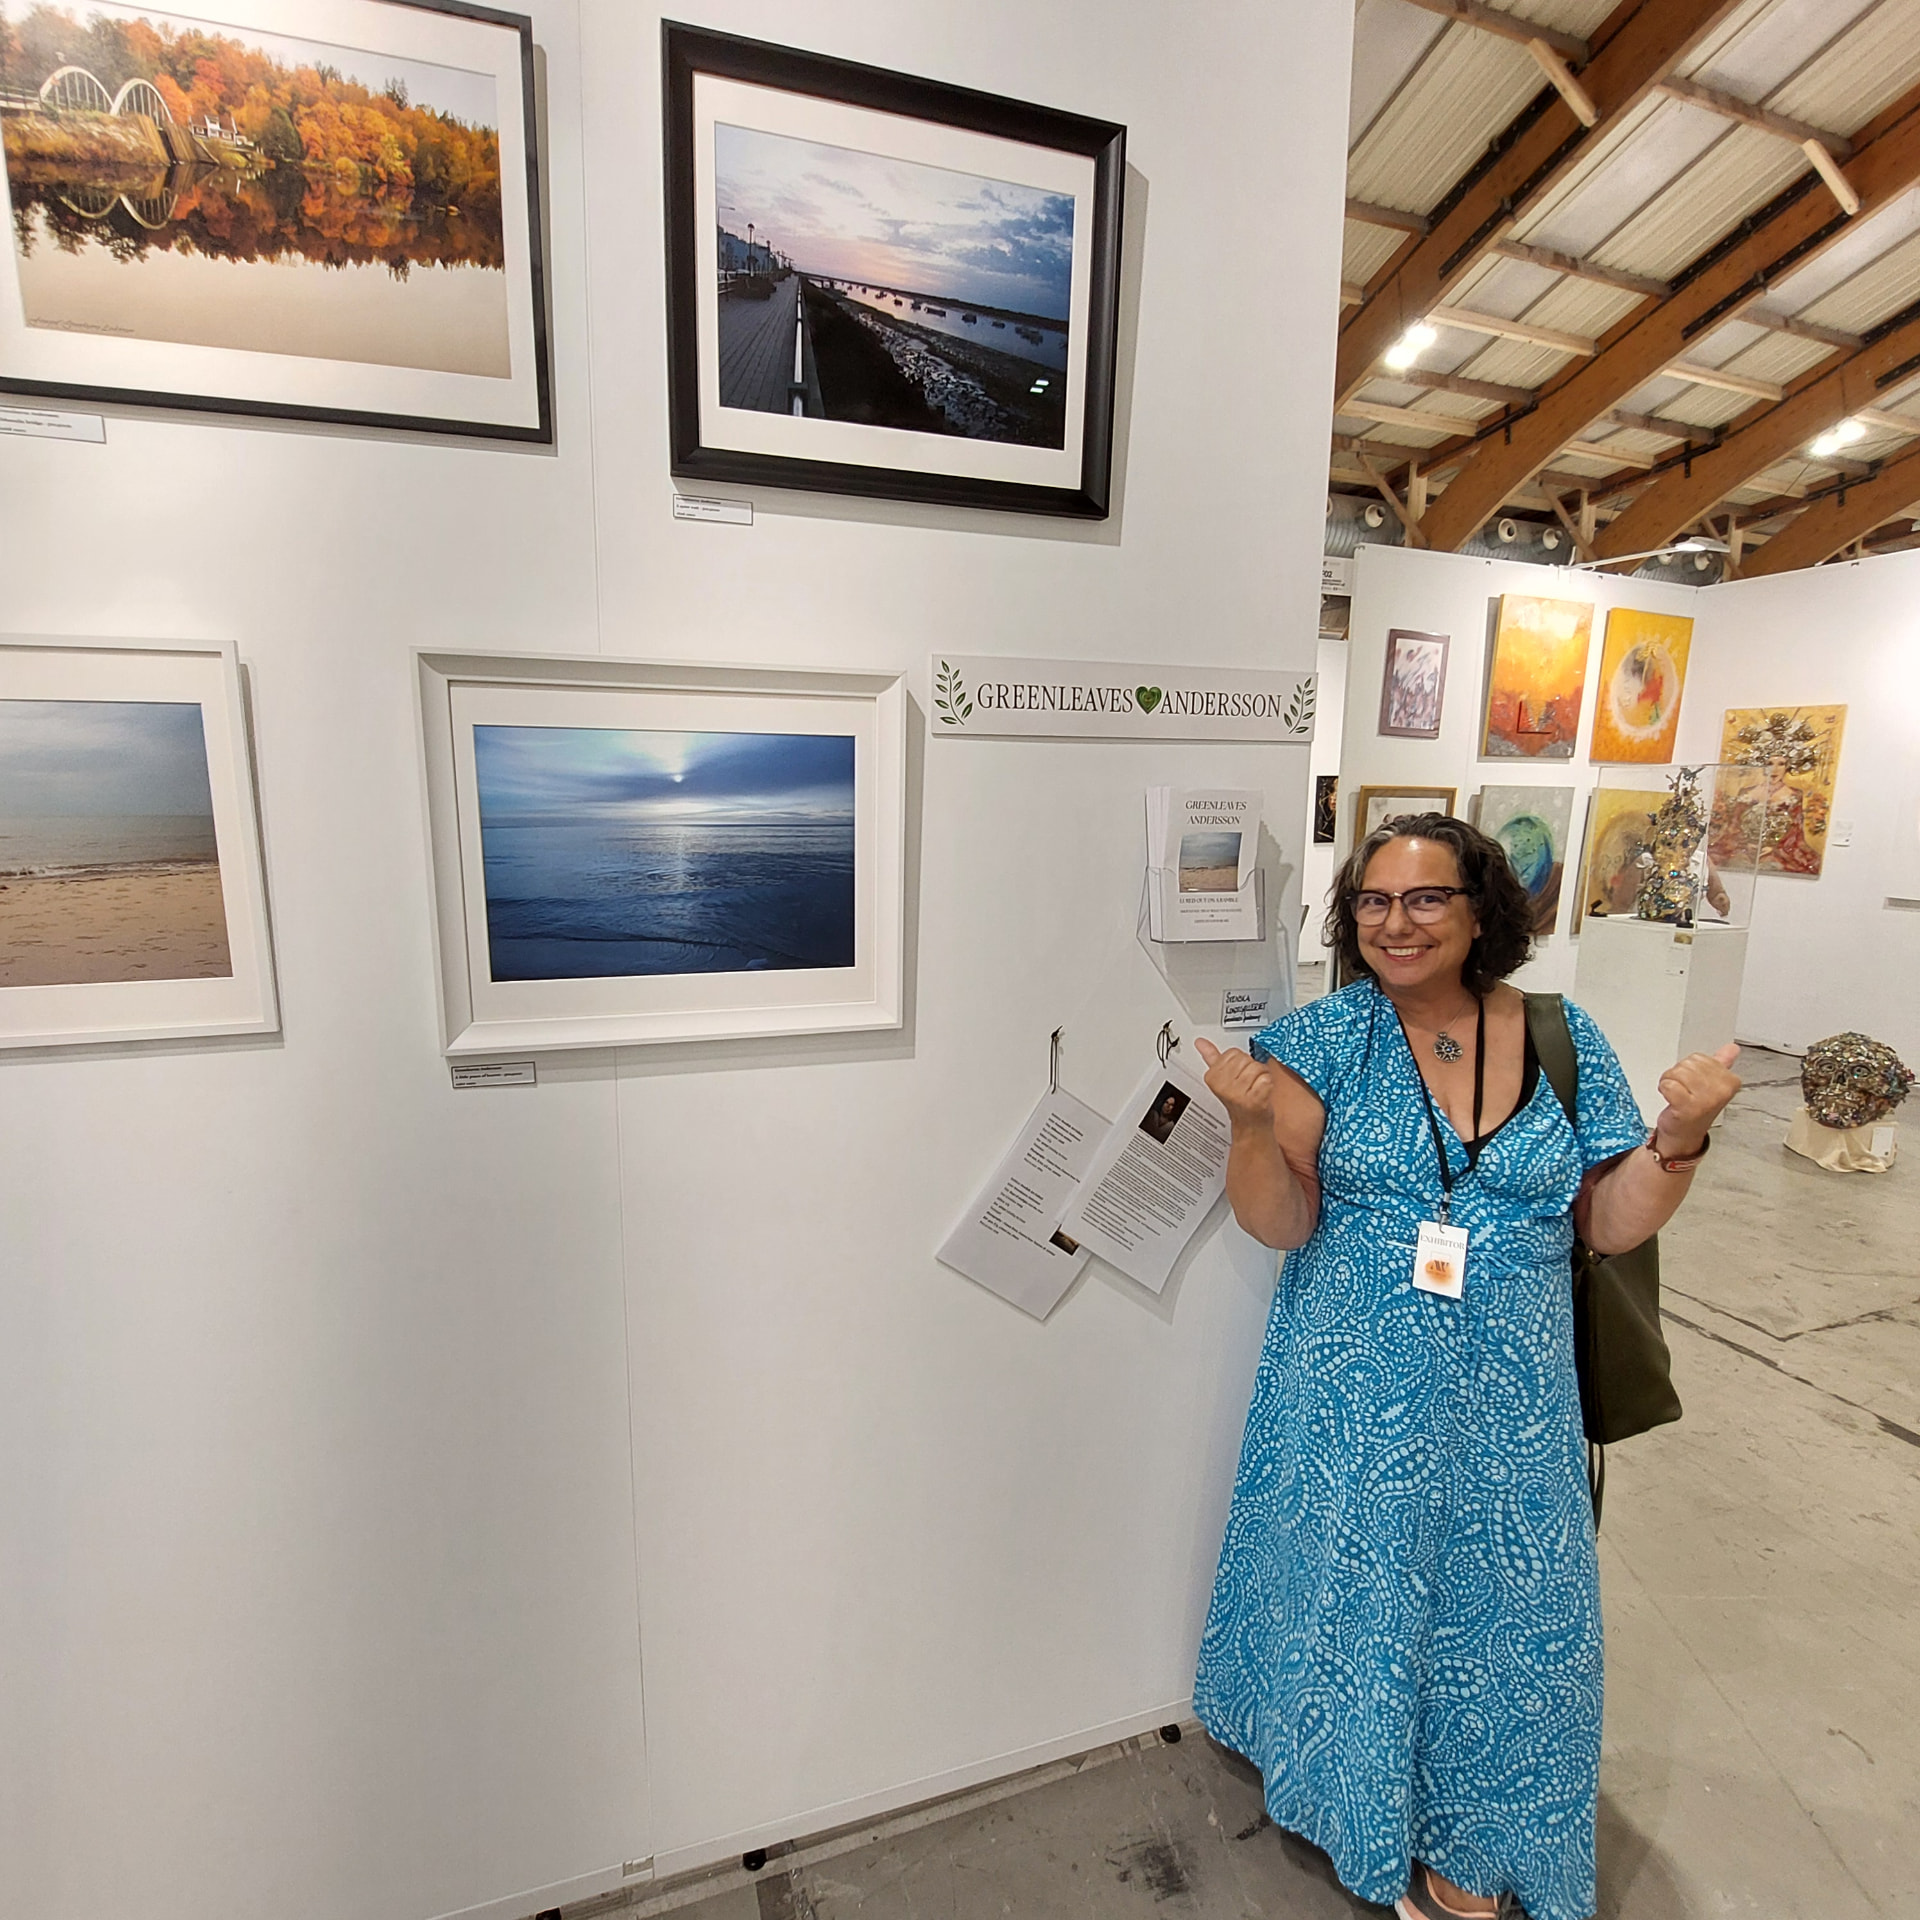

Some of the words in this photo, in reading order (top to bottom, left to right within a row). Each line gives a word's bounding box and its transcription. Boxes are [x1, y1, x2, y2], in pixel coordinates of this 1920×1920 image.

[977, 683, 1133, 713] GREENLEAVES
[1160, 690, 1282, 718] ANDERSSON
[1185, 800, 1247, 811] GREENLEAVES
[1187, 815, 1241, 825] ANDERSSON
[1420, 1234, 1465, 1250] EXHIBITOR
